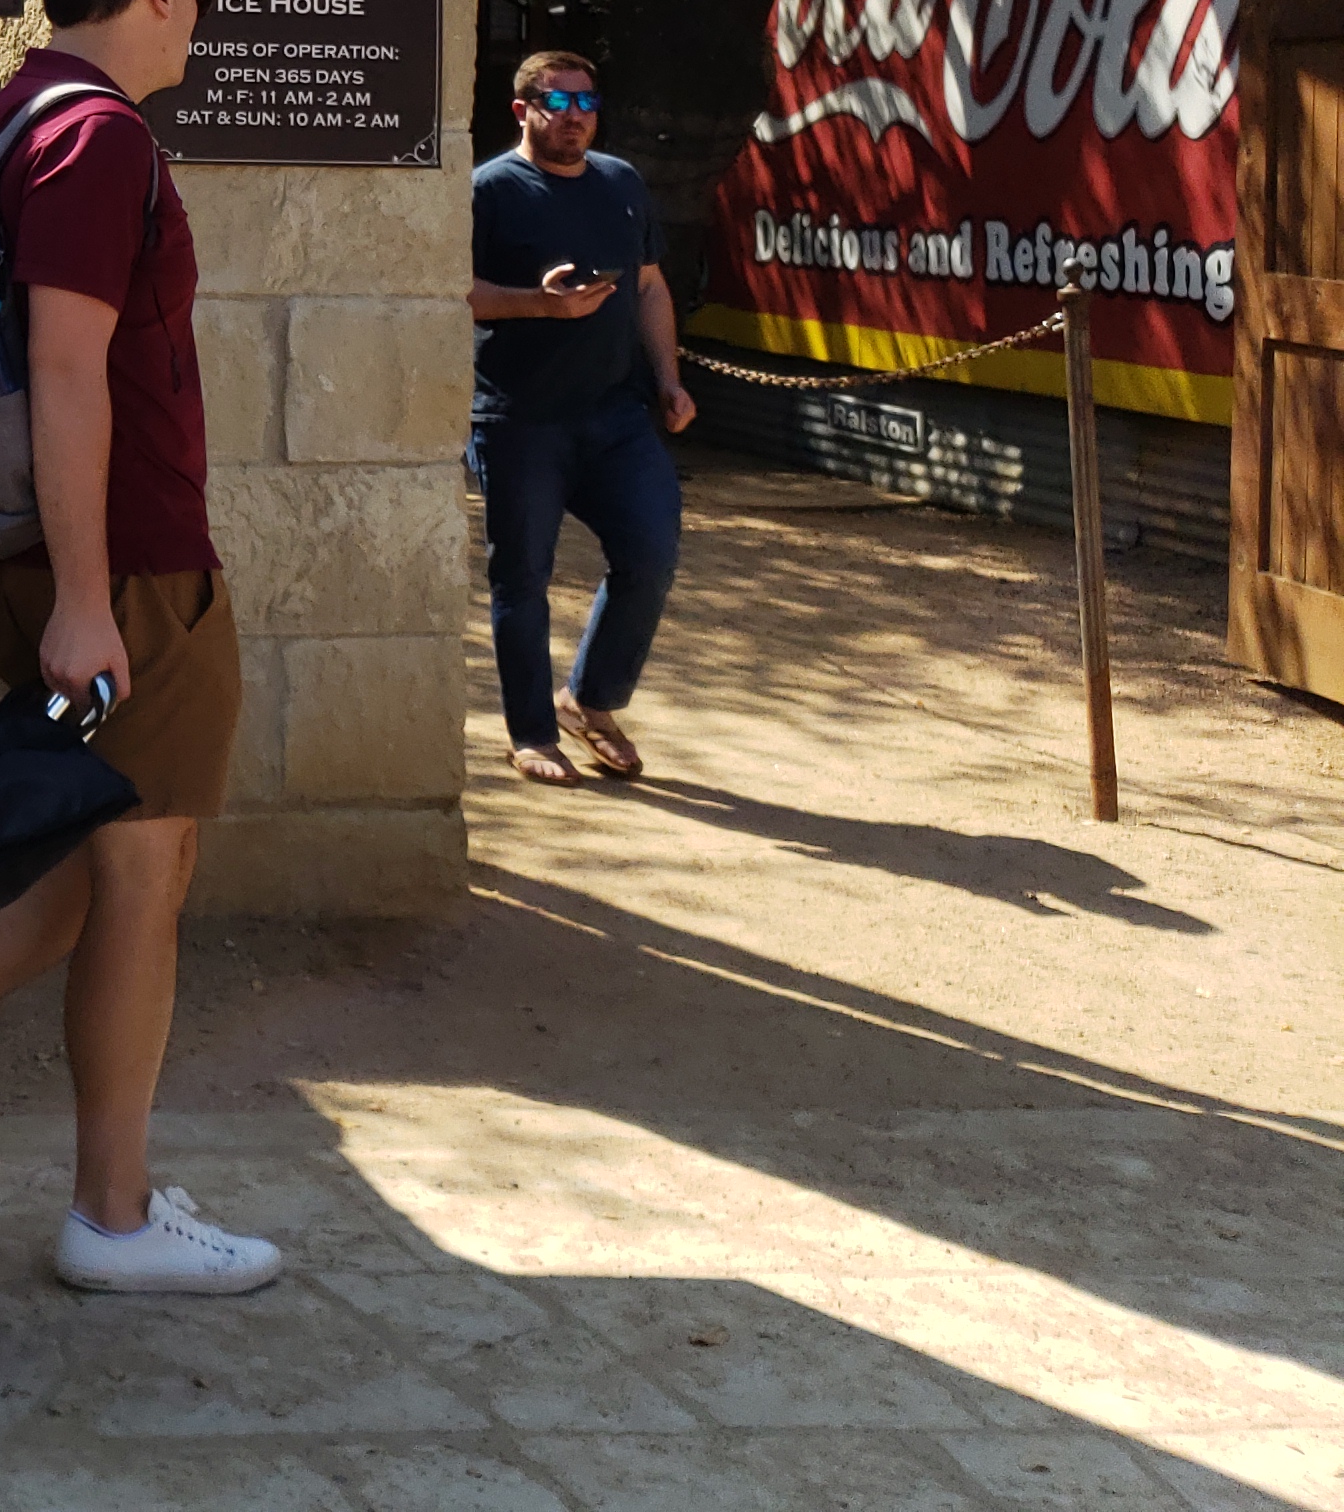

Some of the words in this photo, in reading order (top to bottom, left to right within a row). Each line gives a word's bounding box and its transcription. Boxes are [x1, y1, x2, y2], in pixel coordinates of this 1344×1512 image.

[252, 43, 280, 58] OF
[283, 44, 400, 60] OPERATION:
[214, 67, 271, 83] OPEN
[274, 69, 312, 84] 365
[315, 70, 365, 85] DAYS
[206, 89, 224, 104] M
[236, 90, 254, 104] F:
[260, 90, 277, 104] 11
[283, 91, 313, 106] AM
[325, 91, 339, 106] 2
[341, 92, 372, 107] AM
[175, 110, 214, 125] SAT
[216, 111, 232, 125] &
[234, 111, 282, 127] SUN:
[287, 112, 309, 127] 10
[312, 112, 342, 127] AM
[354, 113, 367, 128] 2
[370, 113, 400, 129] AM
[754, 209, 899, 272] Delicious
[907, 219, 974, 279] and
[984, 220, 1236, 323] Refreshing
[833, 402, 916, 445] Ralston
